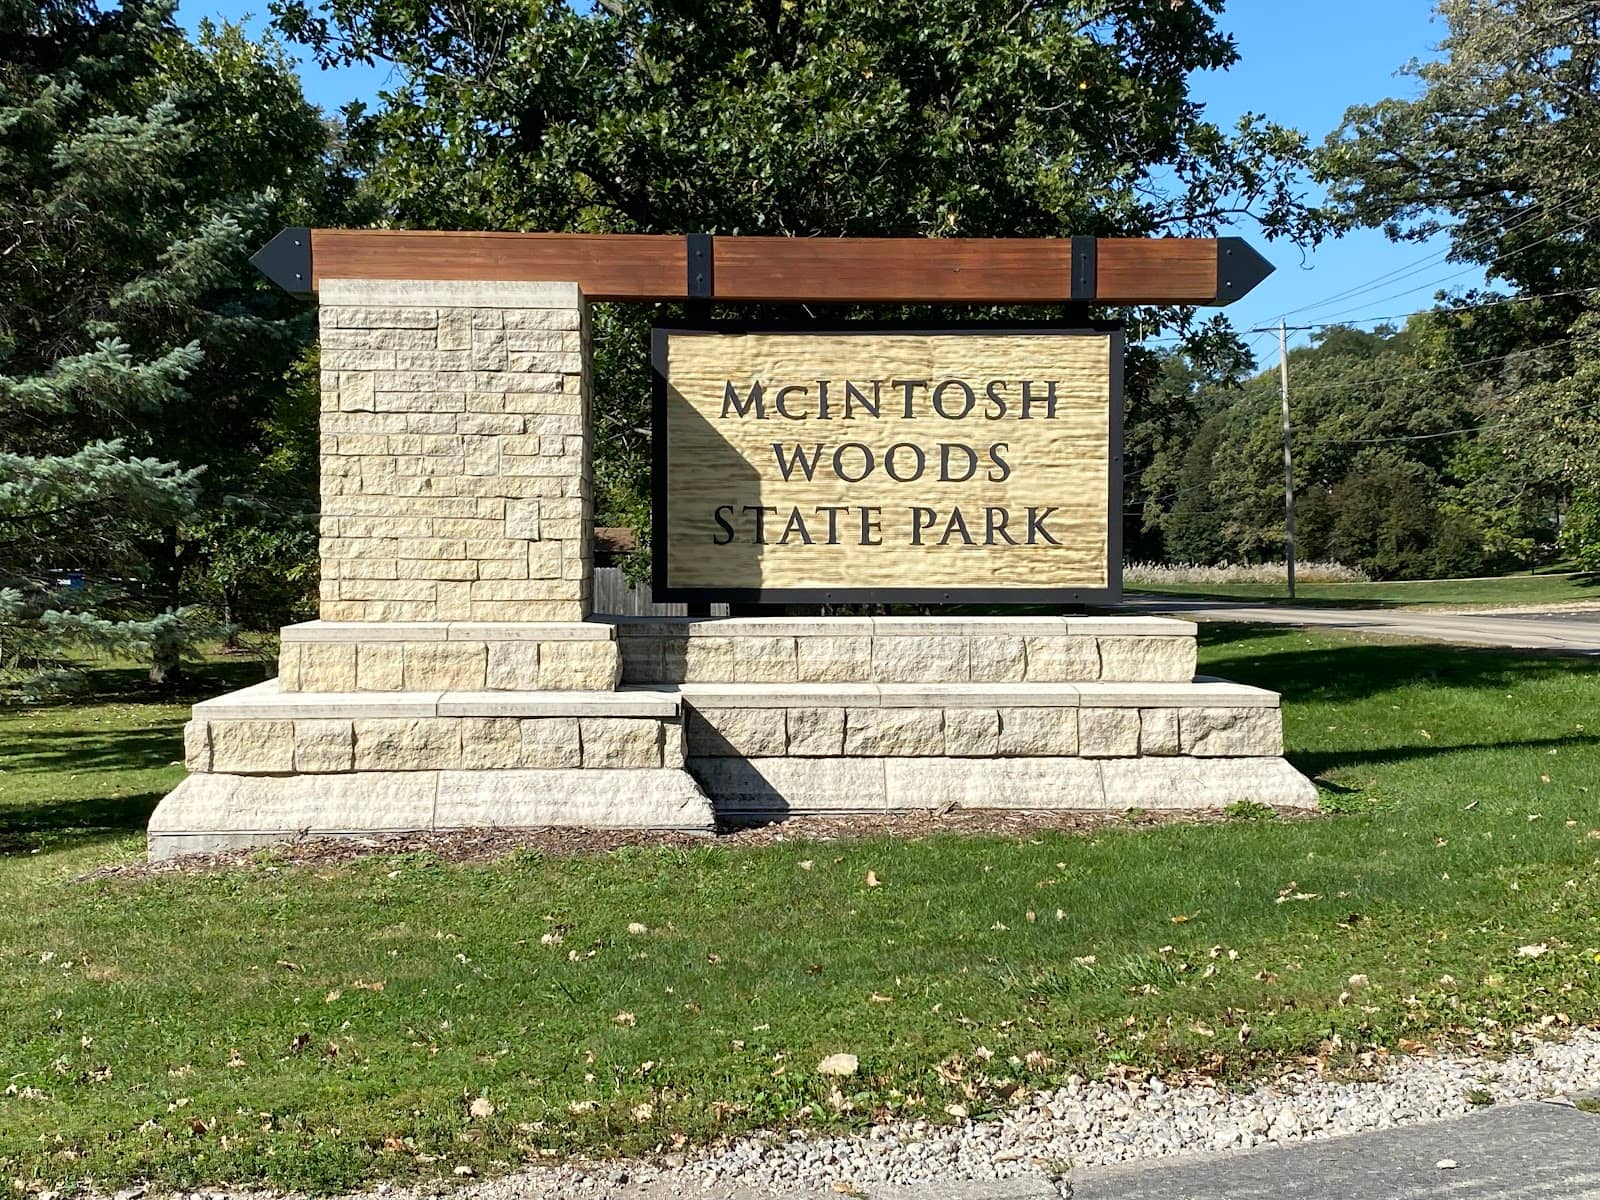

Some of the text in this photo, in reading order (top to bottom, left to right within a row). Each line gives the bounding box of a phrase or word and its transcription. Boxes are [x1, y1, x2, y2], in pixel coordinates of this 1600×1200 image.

[772, 442, 1010, 483] WOODS
[712, 505, 1062, 546] STATE PARK
